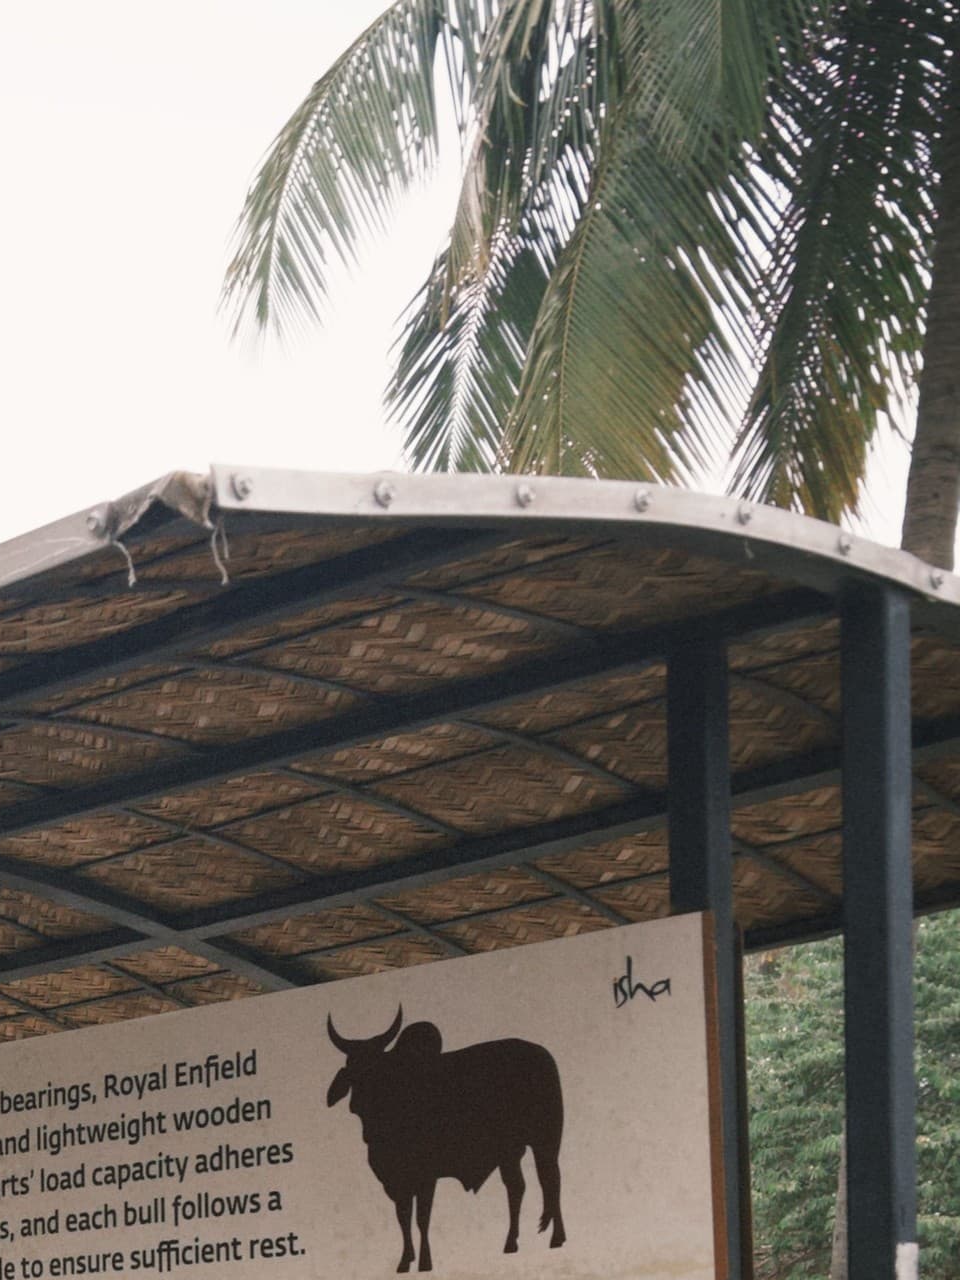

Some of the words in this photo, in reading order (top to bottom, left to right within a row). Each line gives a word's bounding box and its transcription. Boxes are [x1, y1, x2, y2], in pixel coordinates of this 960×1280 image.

[0, 1082, 96, 1114] bearings,
[104, 1064, 167, 1100] Royal
[175, 1049, 256, 1088] Enfield
[37, 1111, 167, 1155] lightweight
[173, 1097, 271, 1131] wooden
[41, 1163, 85, 1192] load
[92, 1152, 188, 1190] capacity
[195, 1143, 293, 1174] adheres
[21, 1209, 59, 1237] and
[66, 1204, 117, 1232] each
[124, 1197, 165, 1226] bull
[172, 1192, 261, 1227] follows
[268, 1191, 282, 1211] a
[21, 1258, 43, 1279] to
[49, 1252, 124, 1276] ensure
[130, 1237, 242, 1273] sufficient
[250, 1232, 305, 1259] rest.
